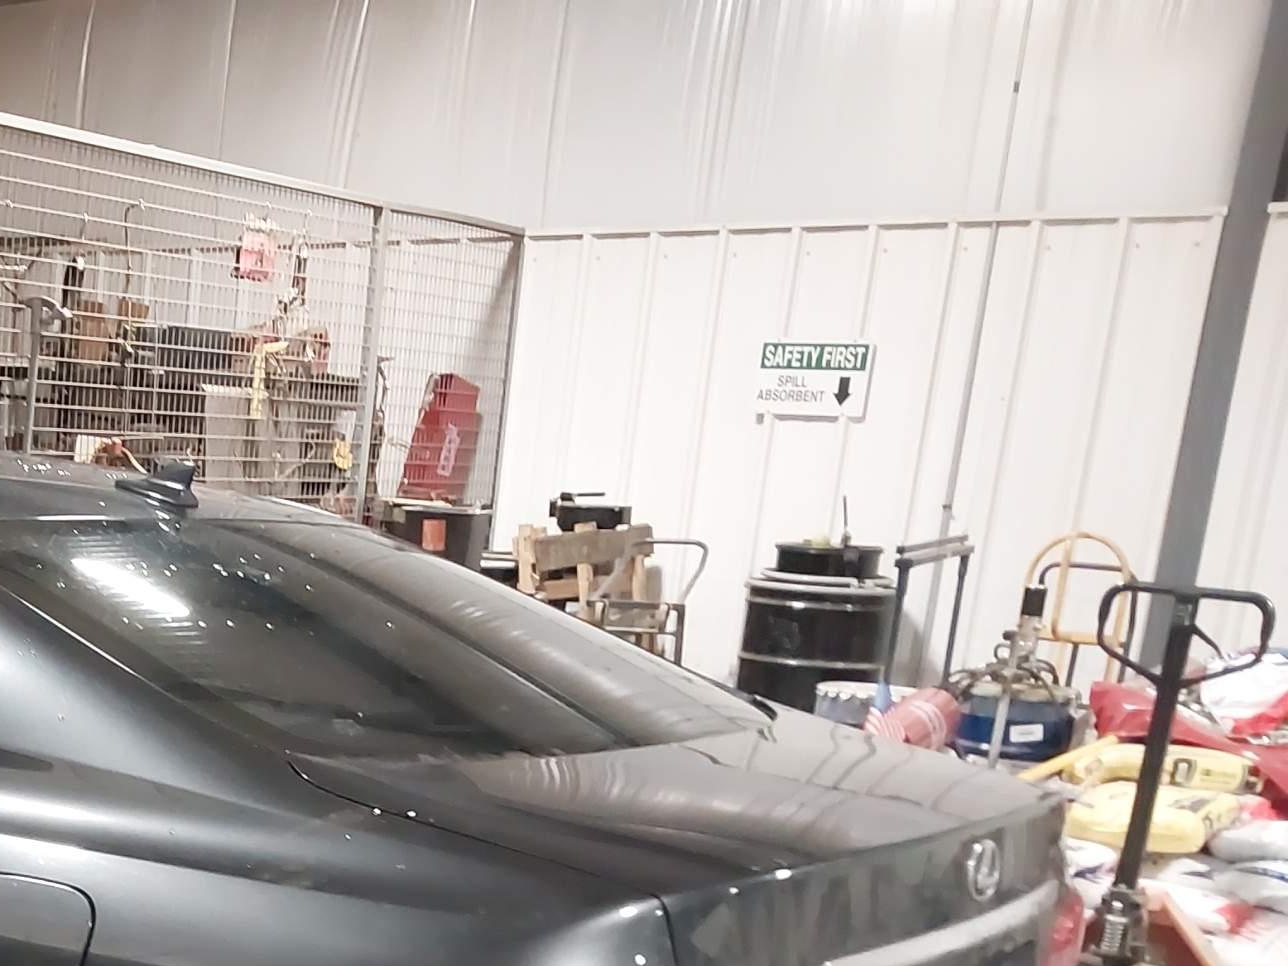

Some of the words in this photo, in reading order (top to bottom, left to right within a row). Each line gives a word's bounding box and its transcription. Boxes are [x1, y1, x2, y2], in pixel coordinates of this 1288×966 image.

[764, 345, 821, 367] SAFETY
[822, 346, 866, 368] FIRST
[777, 375, 807, 388] SPILL
[757, 389, 824, 402] ABSORBENT
